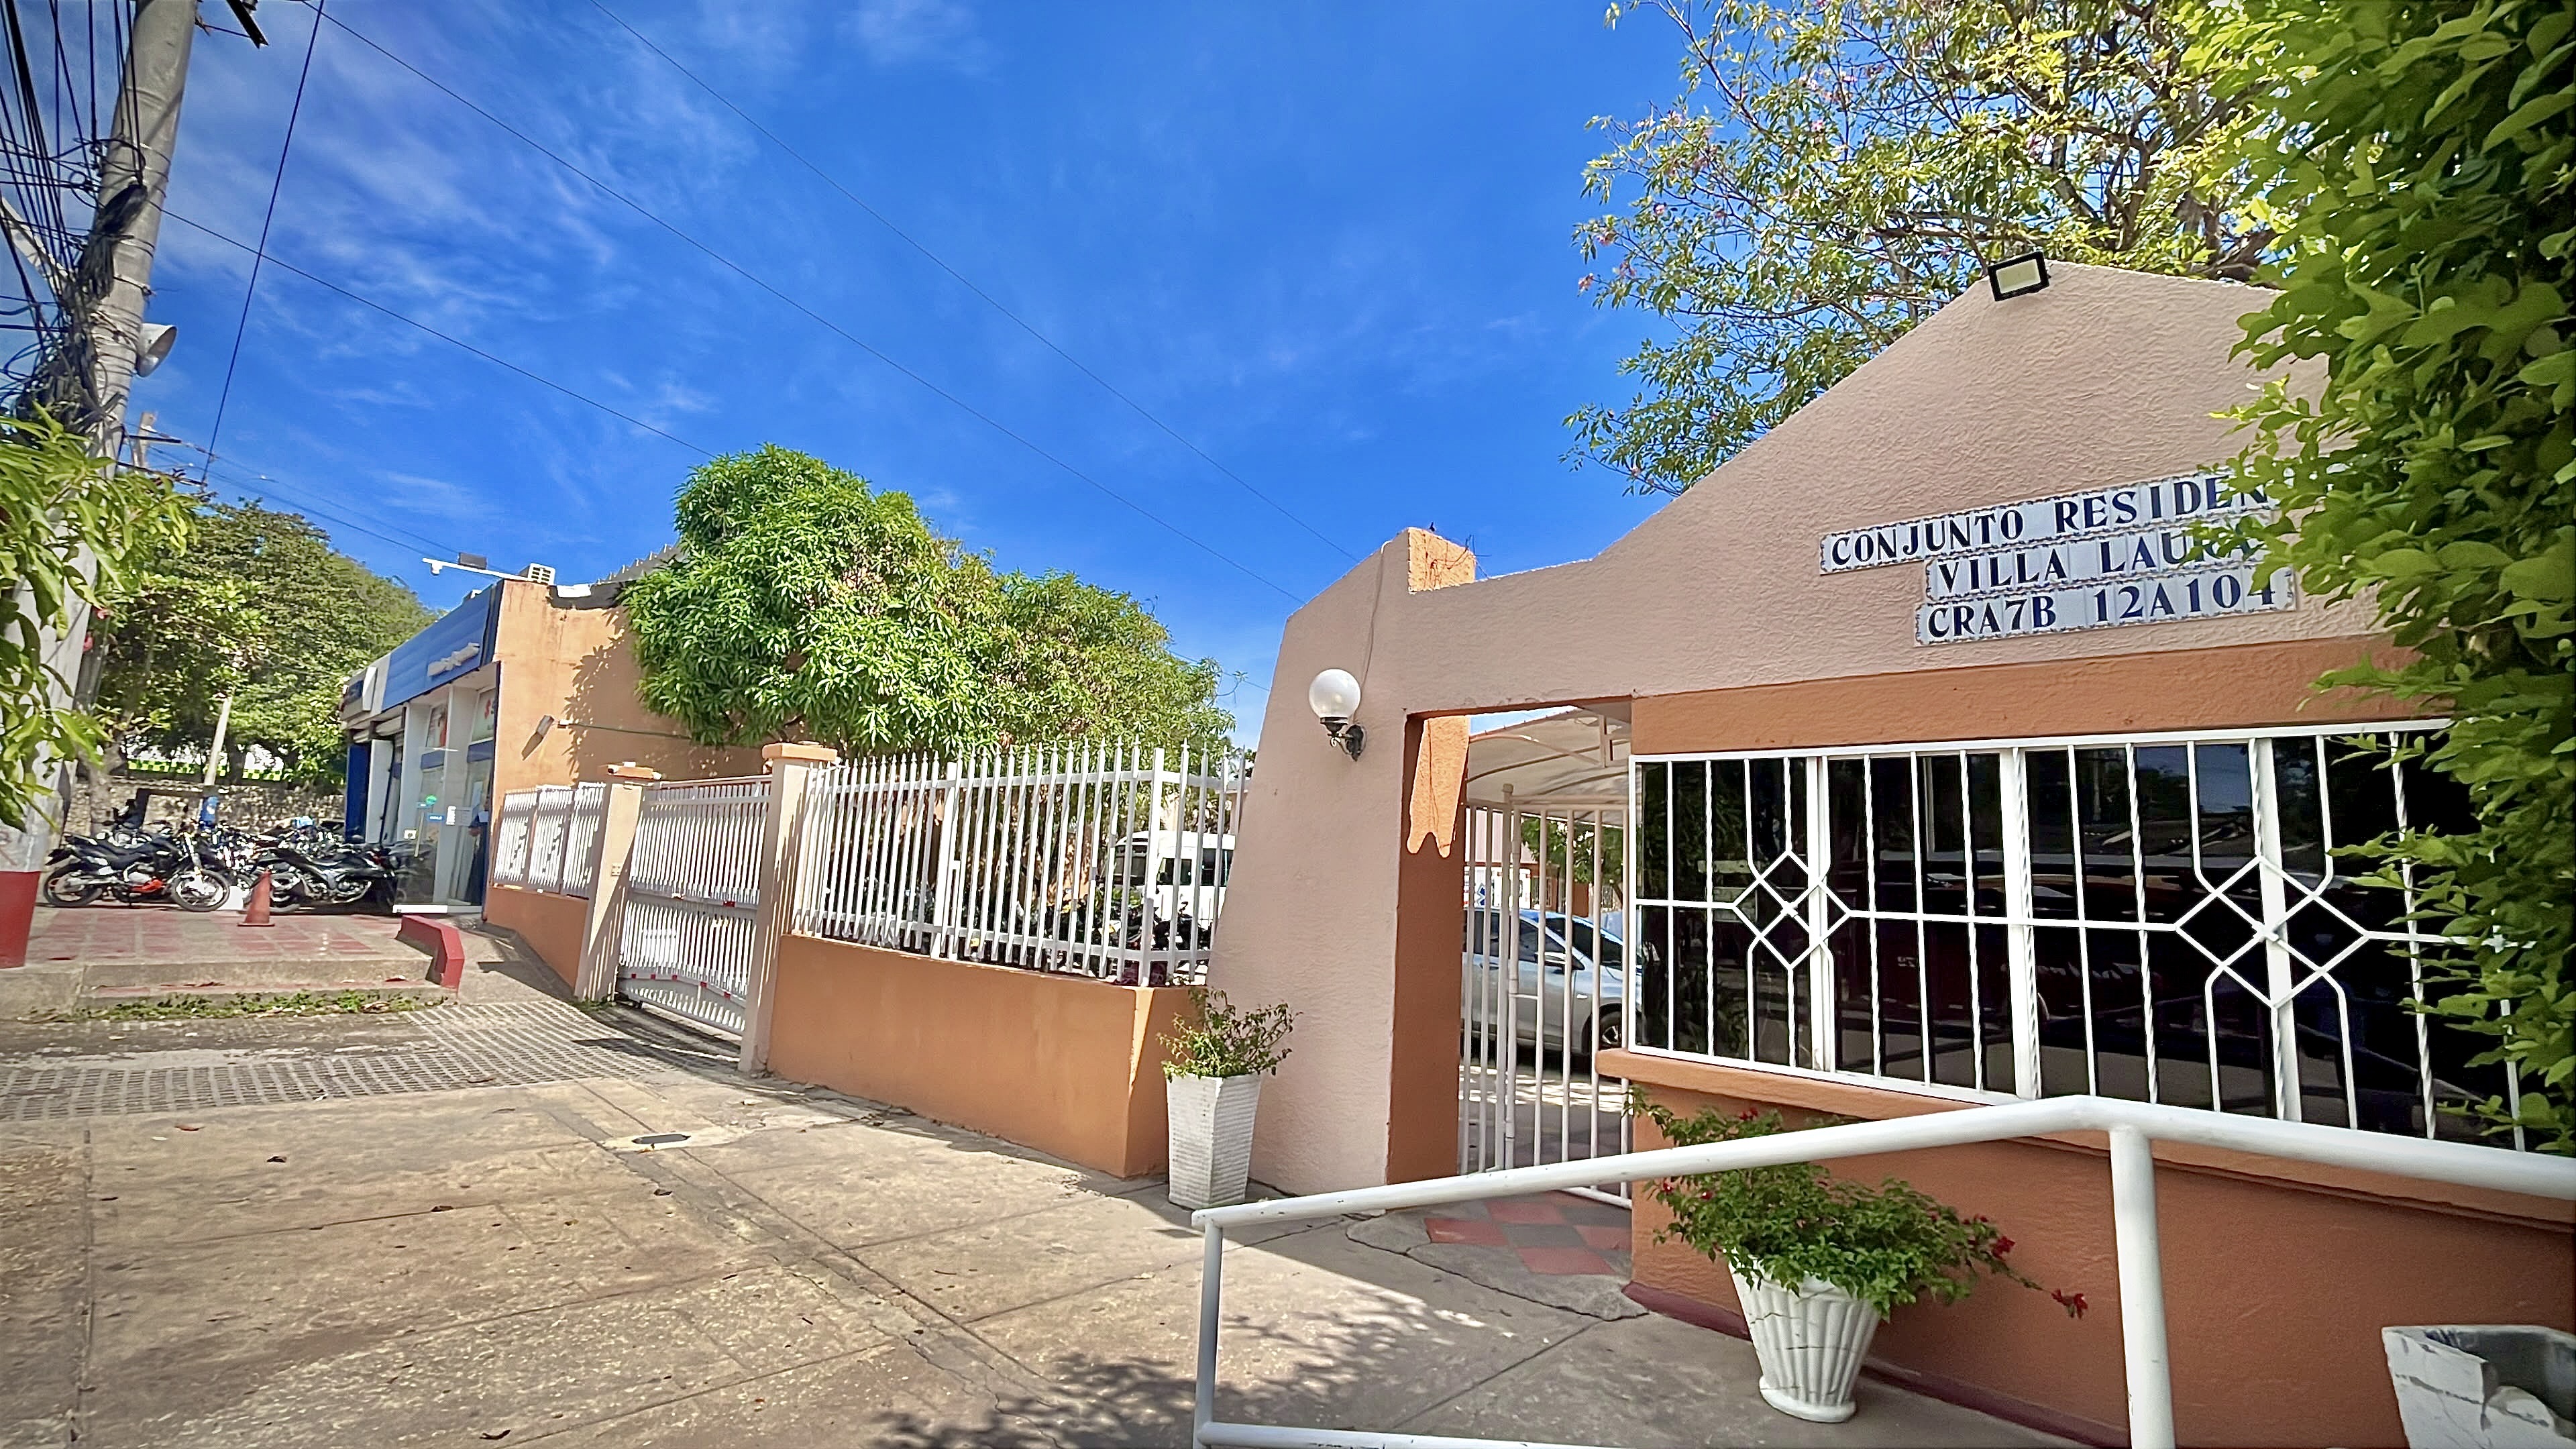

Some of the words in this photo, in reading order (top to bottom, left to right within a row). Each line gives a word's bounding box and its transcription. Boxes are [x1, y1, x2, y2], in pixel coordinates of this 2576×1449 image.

[1832, 509, 2024, 566] CONJUNTO
[1938, 548, 2067, 593] VILLA
[1928, 595, 2056, 638] CRA7B
